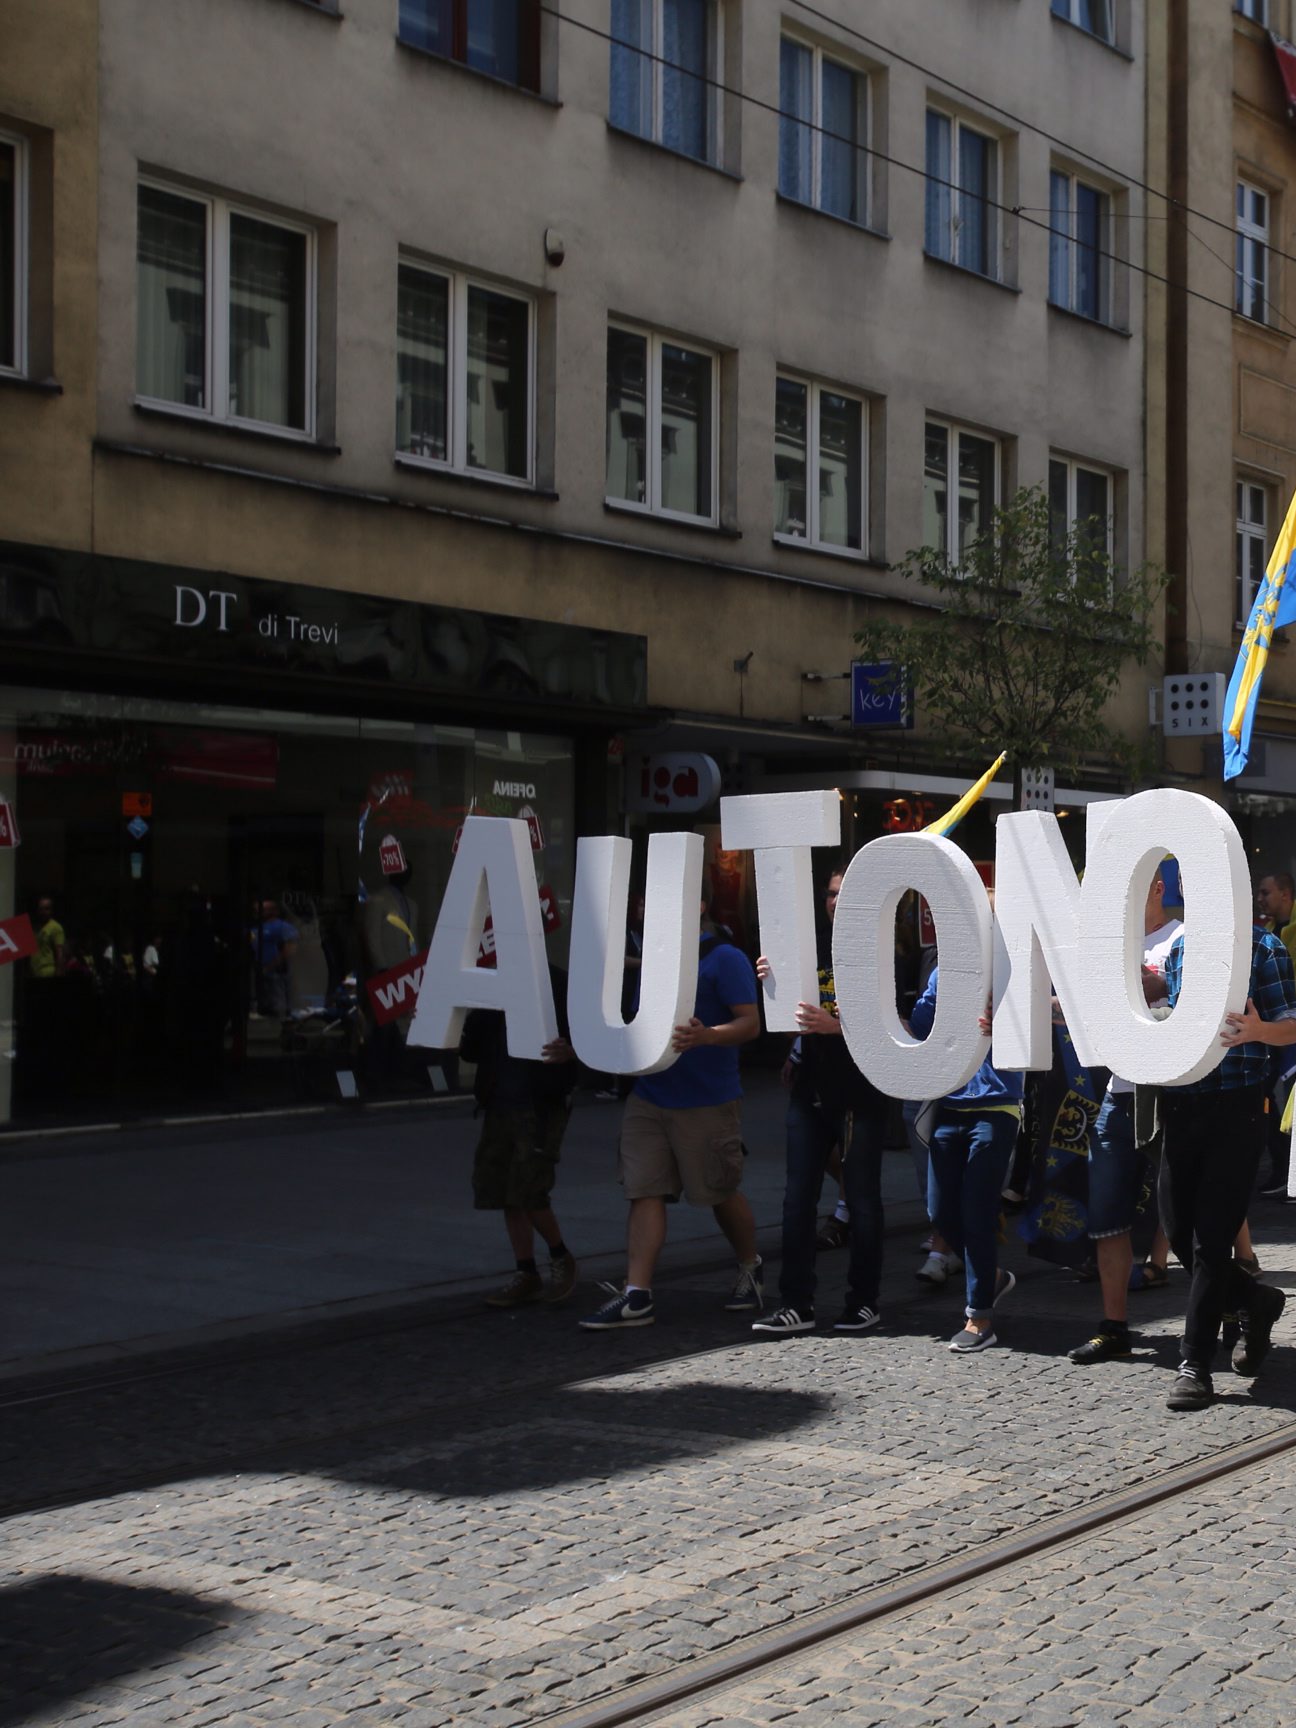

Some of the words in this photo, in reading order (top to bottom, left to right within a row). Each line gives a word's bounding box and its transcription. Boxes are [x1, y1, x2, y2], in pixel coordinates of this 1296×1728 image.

[174, 585, 238, 632] DT
[258, 613, 279, 638] di
[286, 615, 339, 645] Trevi
[1171, 716, 1209, 728] SIX
